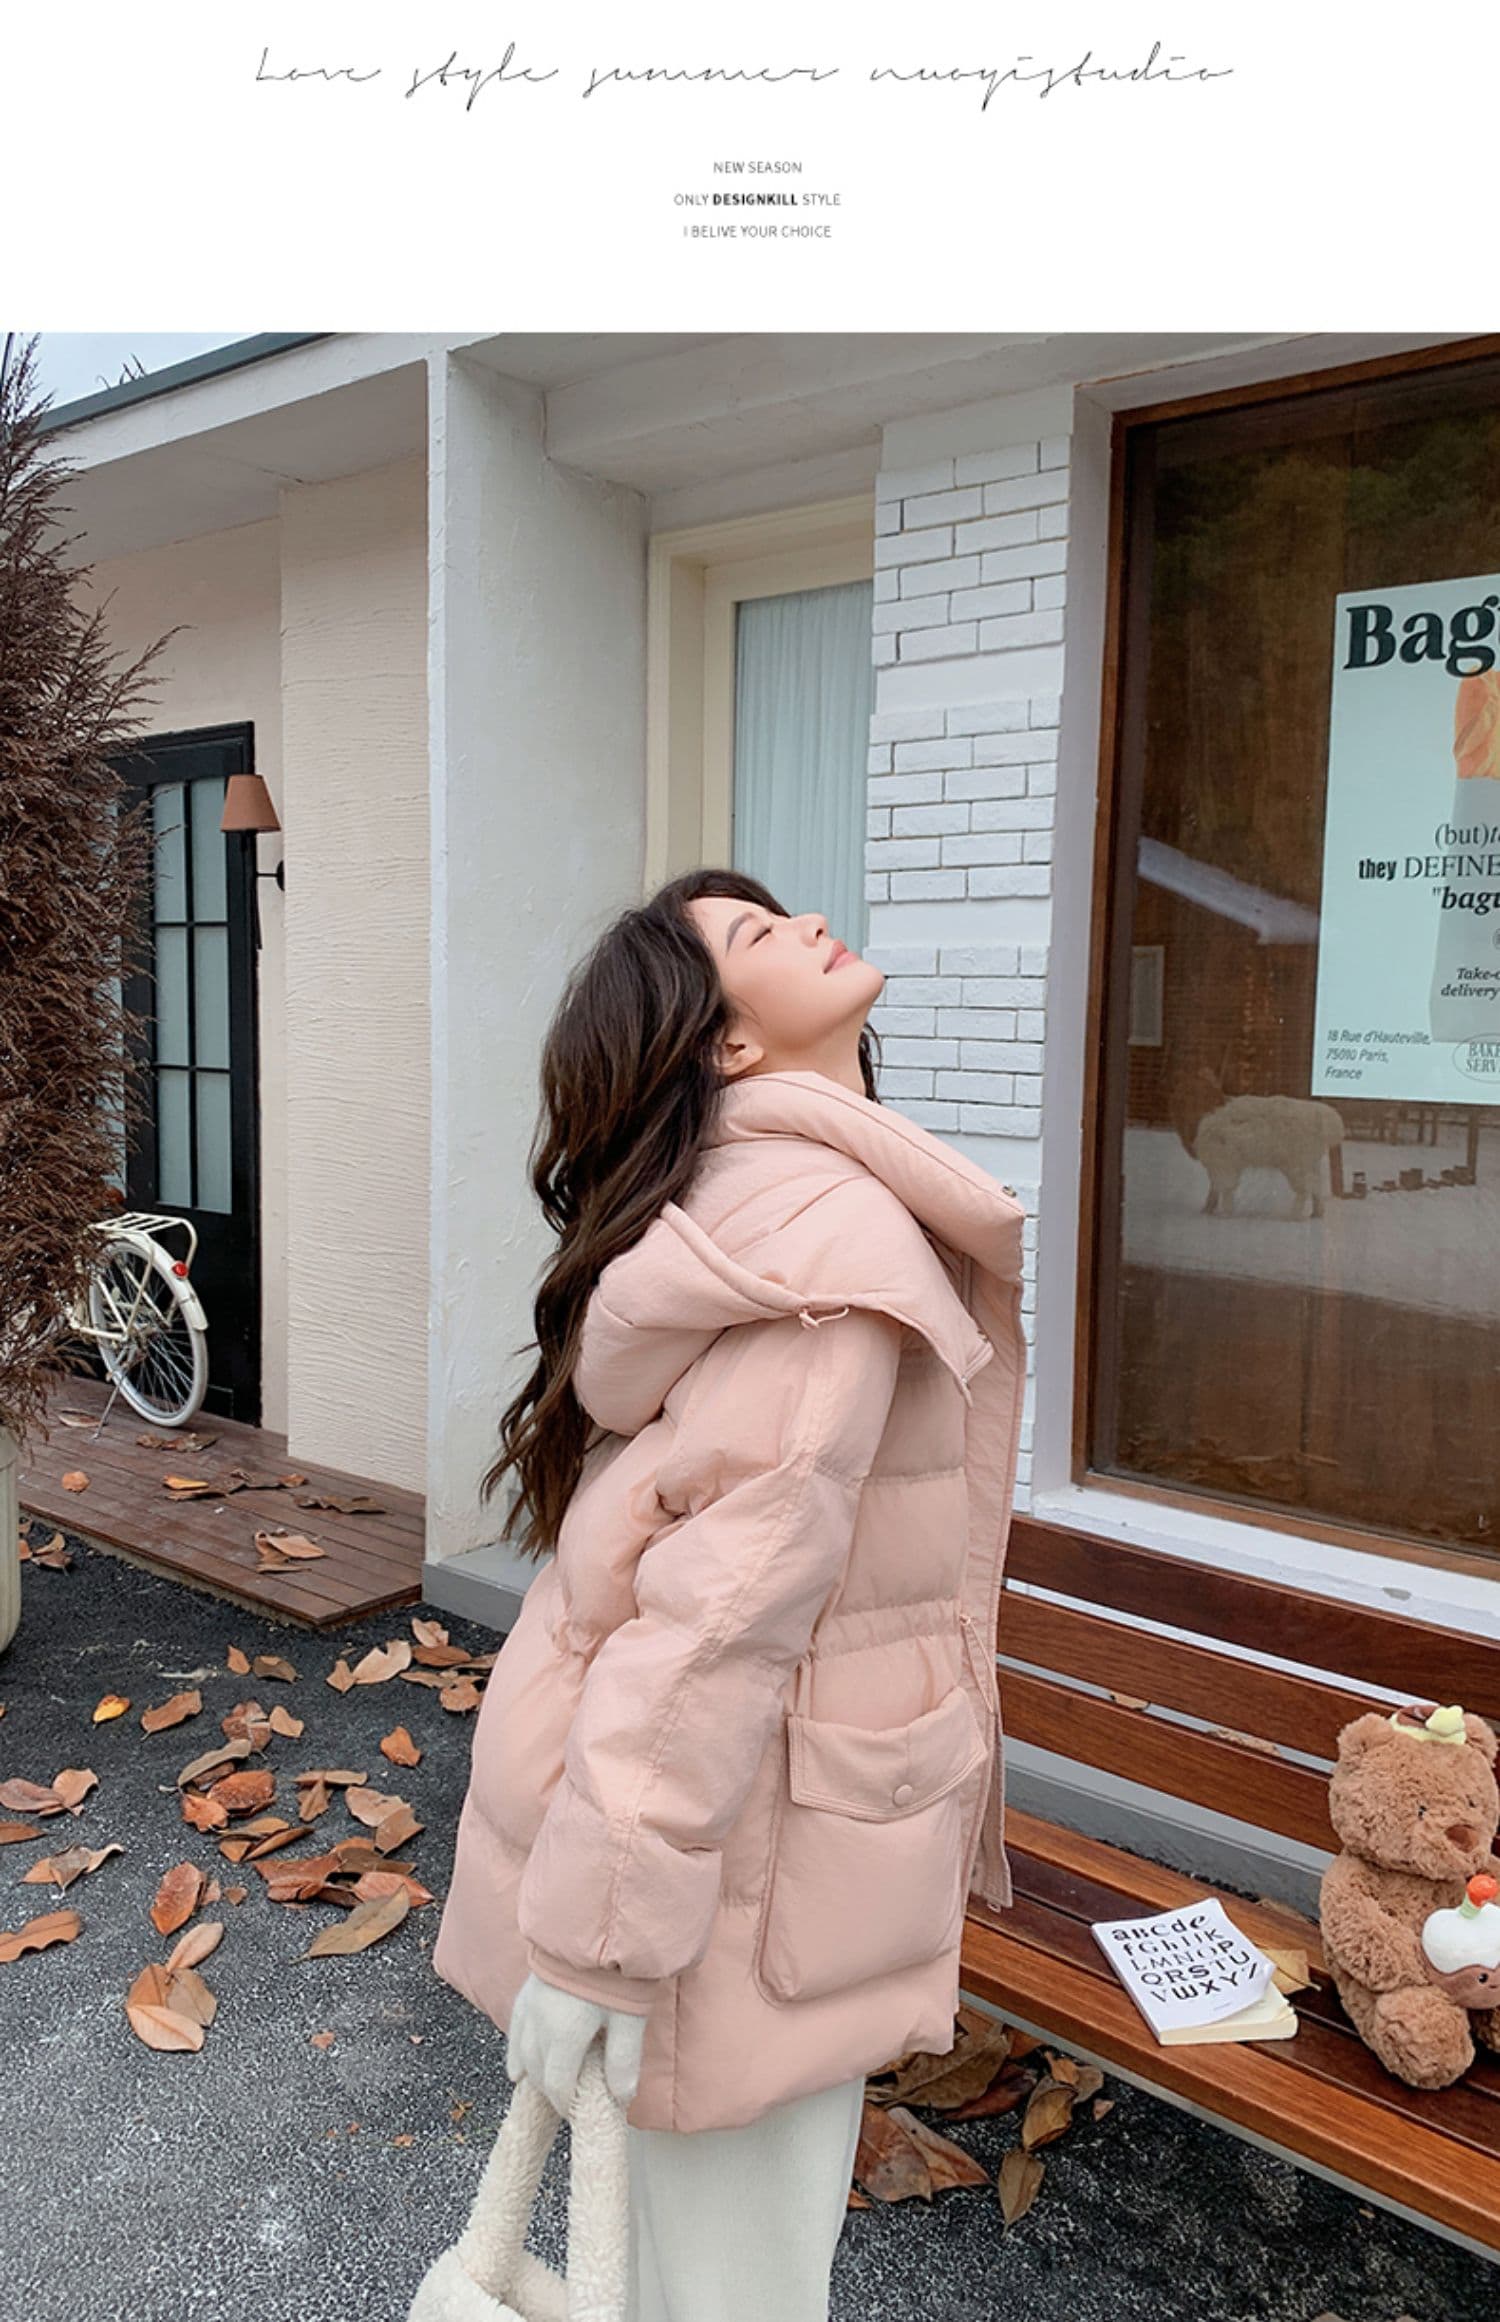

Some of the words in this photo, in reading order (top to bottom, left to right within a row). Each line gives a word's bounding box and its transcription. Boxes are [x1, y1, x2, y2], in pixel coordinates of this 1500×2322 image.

[1343, 595, 1500, 678] Bag
[1358, 858, 1397, 881] they
[1404, 855, 1500, 878] DEFINE
[1440, 984, 1498, 1001] delivery
[1340, 1029, 1362, 1043] Rue
[1324, 1066, 1363, 1080] France
[1465, 1058, 1500, 1073] SERV
